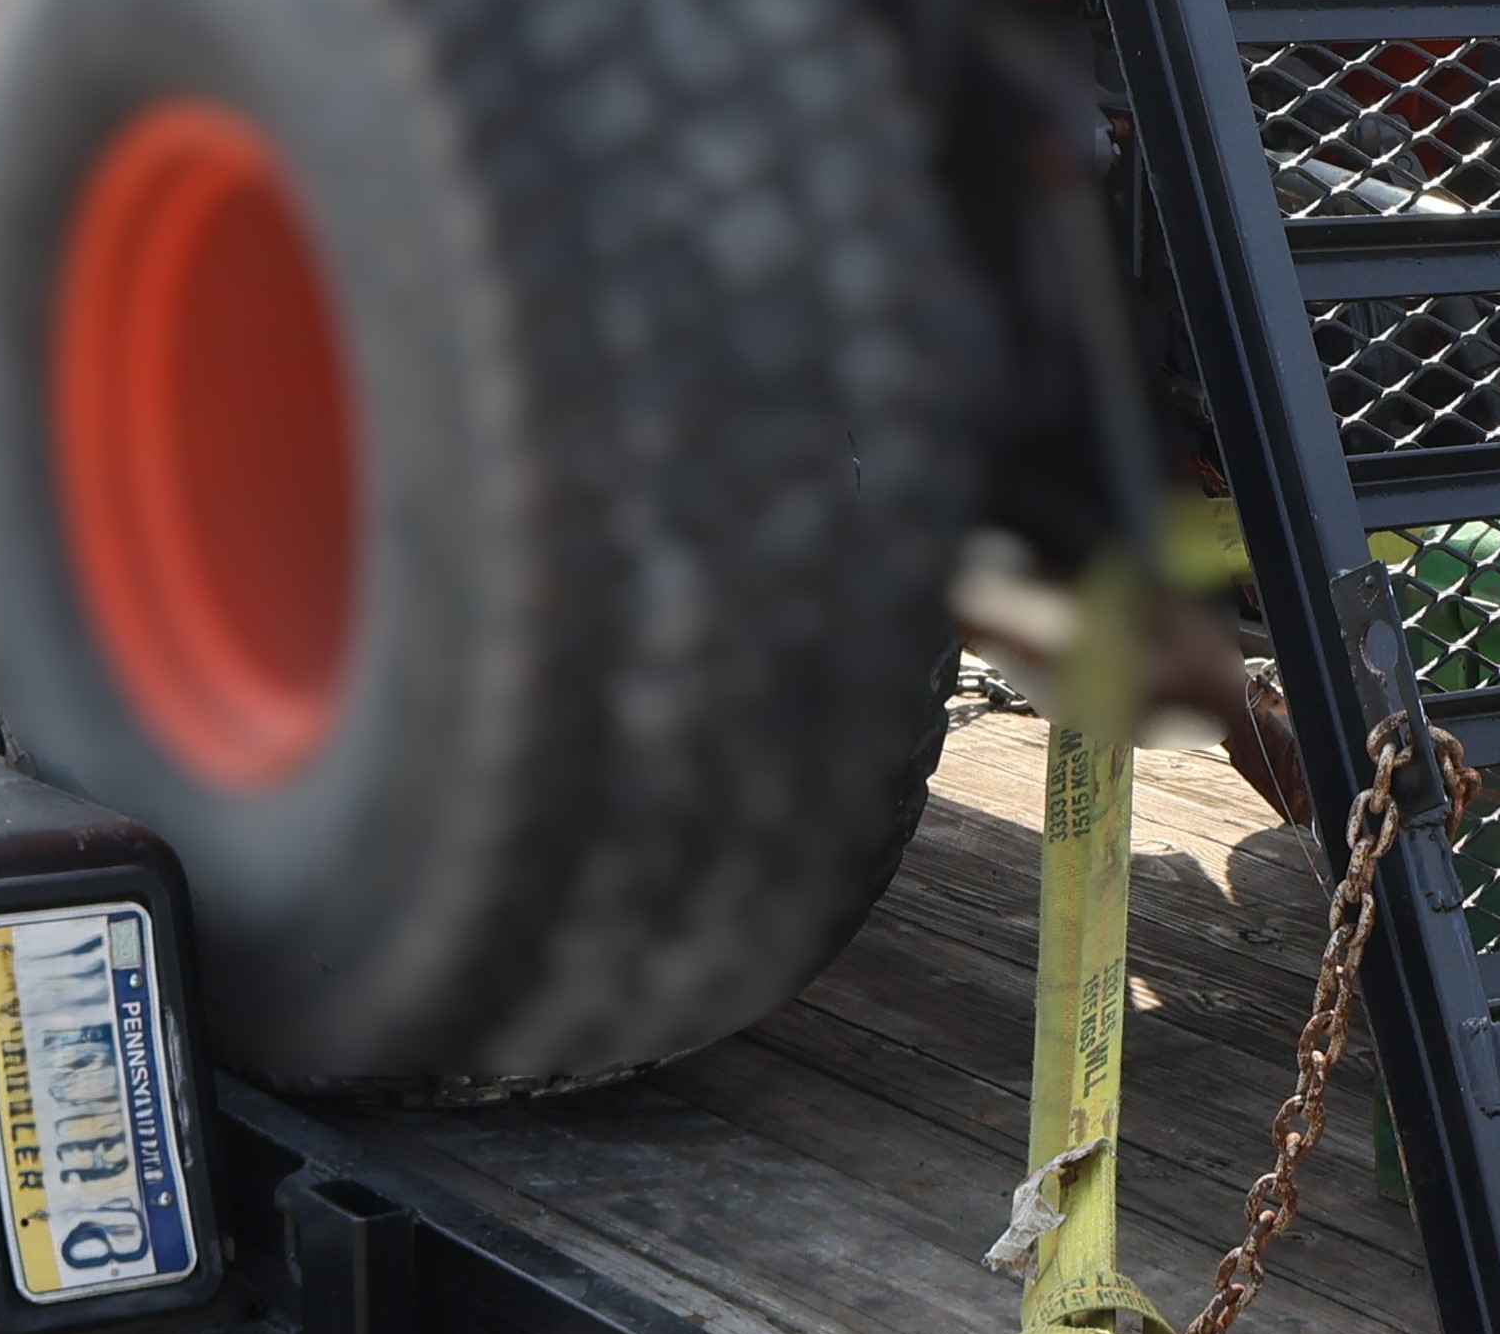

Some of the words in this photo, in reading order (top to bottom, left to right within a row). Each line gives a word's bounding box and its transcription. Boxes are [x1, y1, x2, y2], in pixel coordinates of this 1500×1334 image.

[1049, 759, 1068, 797] LBS
[1070, 749, 1090, 791] KGS
[1048, 797, 1068, 843] 3333
[1071, 791, 1091, 838] 1515
[1080, 973, 1099, 1016] 1515
[1078, 1013, 1098, 1054] KGS
[1099, 999, 1118, 1037] LBS
[1083, 1036, 1109, 1099] WLL
[120, 1000, 164, 1185] PENNSY
